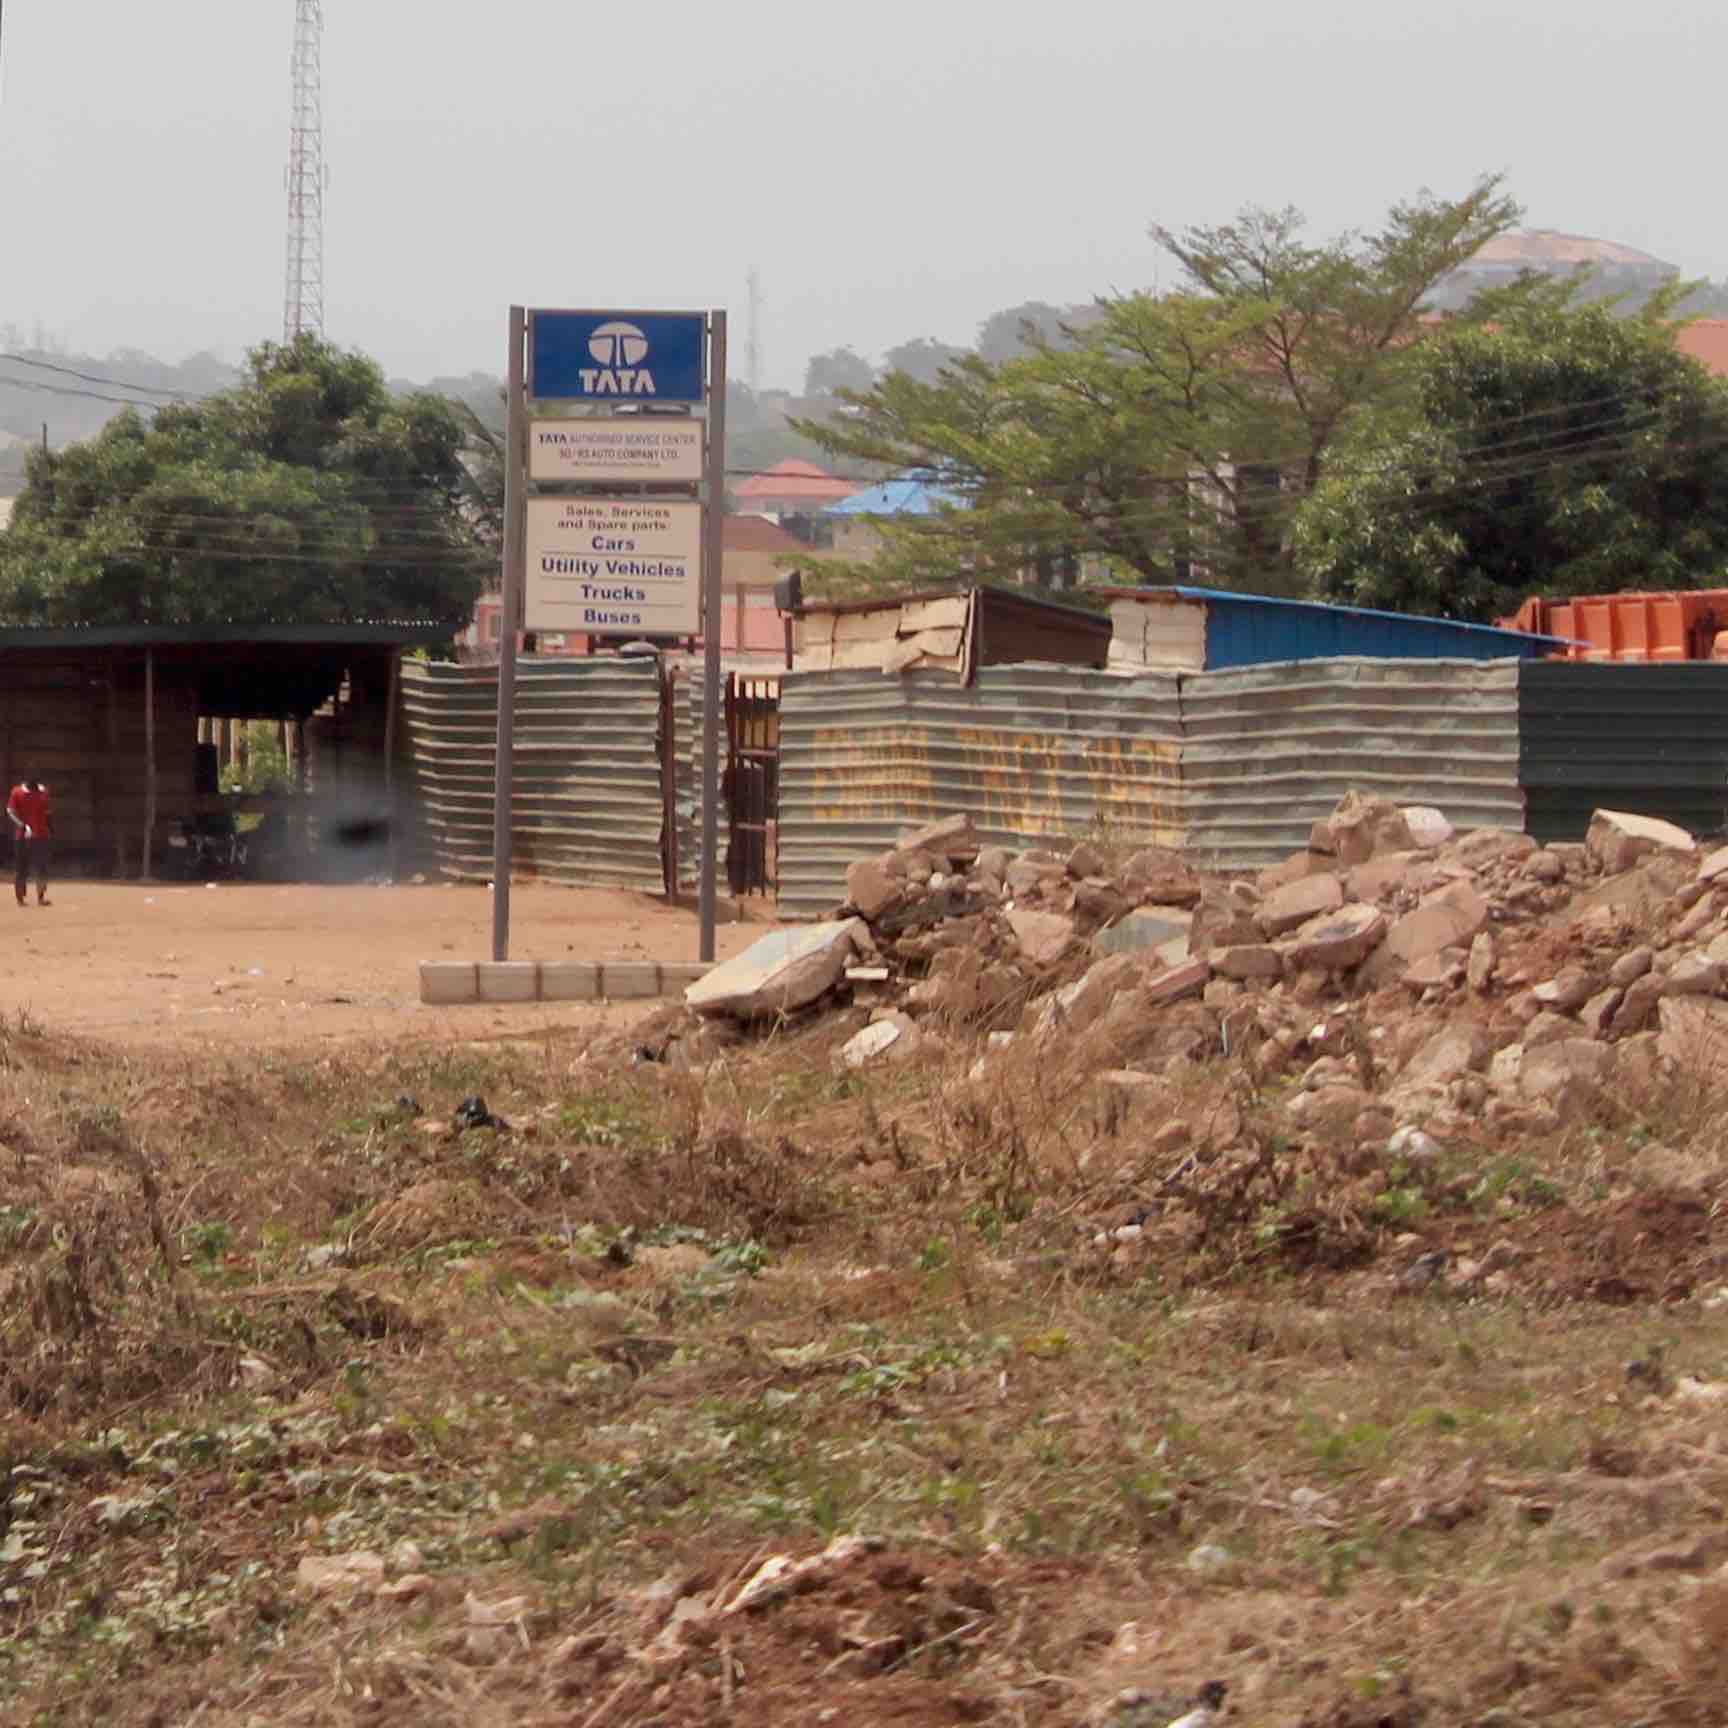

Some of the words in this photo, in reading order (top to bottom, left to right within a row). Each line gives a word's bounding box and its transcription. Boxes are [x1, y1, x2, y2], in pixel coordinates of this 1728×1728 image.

[578, 368, 657, 394] TATA
[539, 433, 567, 444] TATA
[611, 506, 671, 519] Services
[557, 519, 584, 530] and
[588, 519, 629, 532] Spare
[591, 536, 636, 551] Cars
[541, 557, 599, 577] Utility
[605, 560, 686, 577] Vehicles
[581, 584, 646, 601] Trucks
[584, 609, 641, 625] Buses
